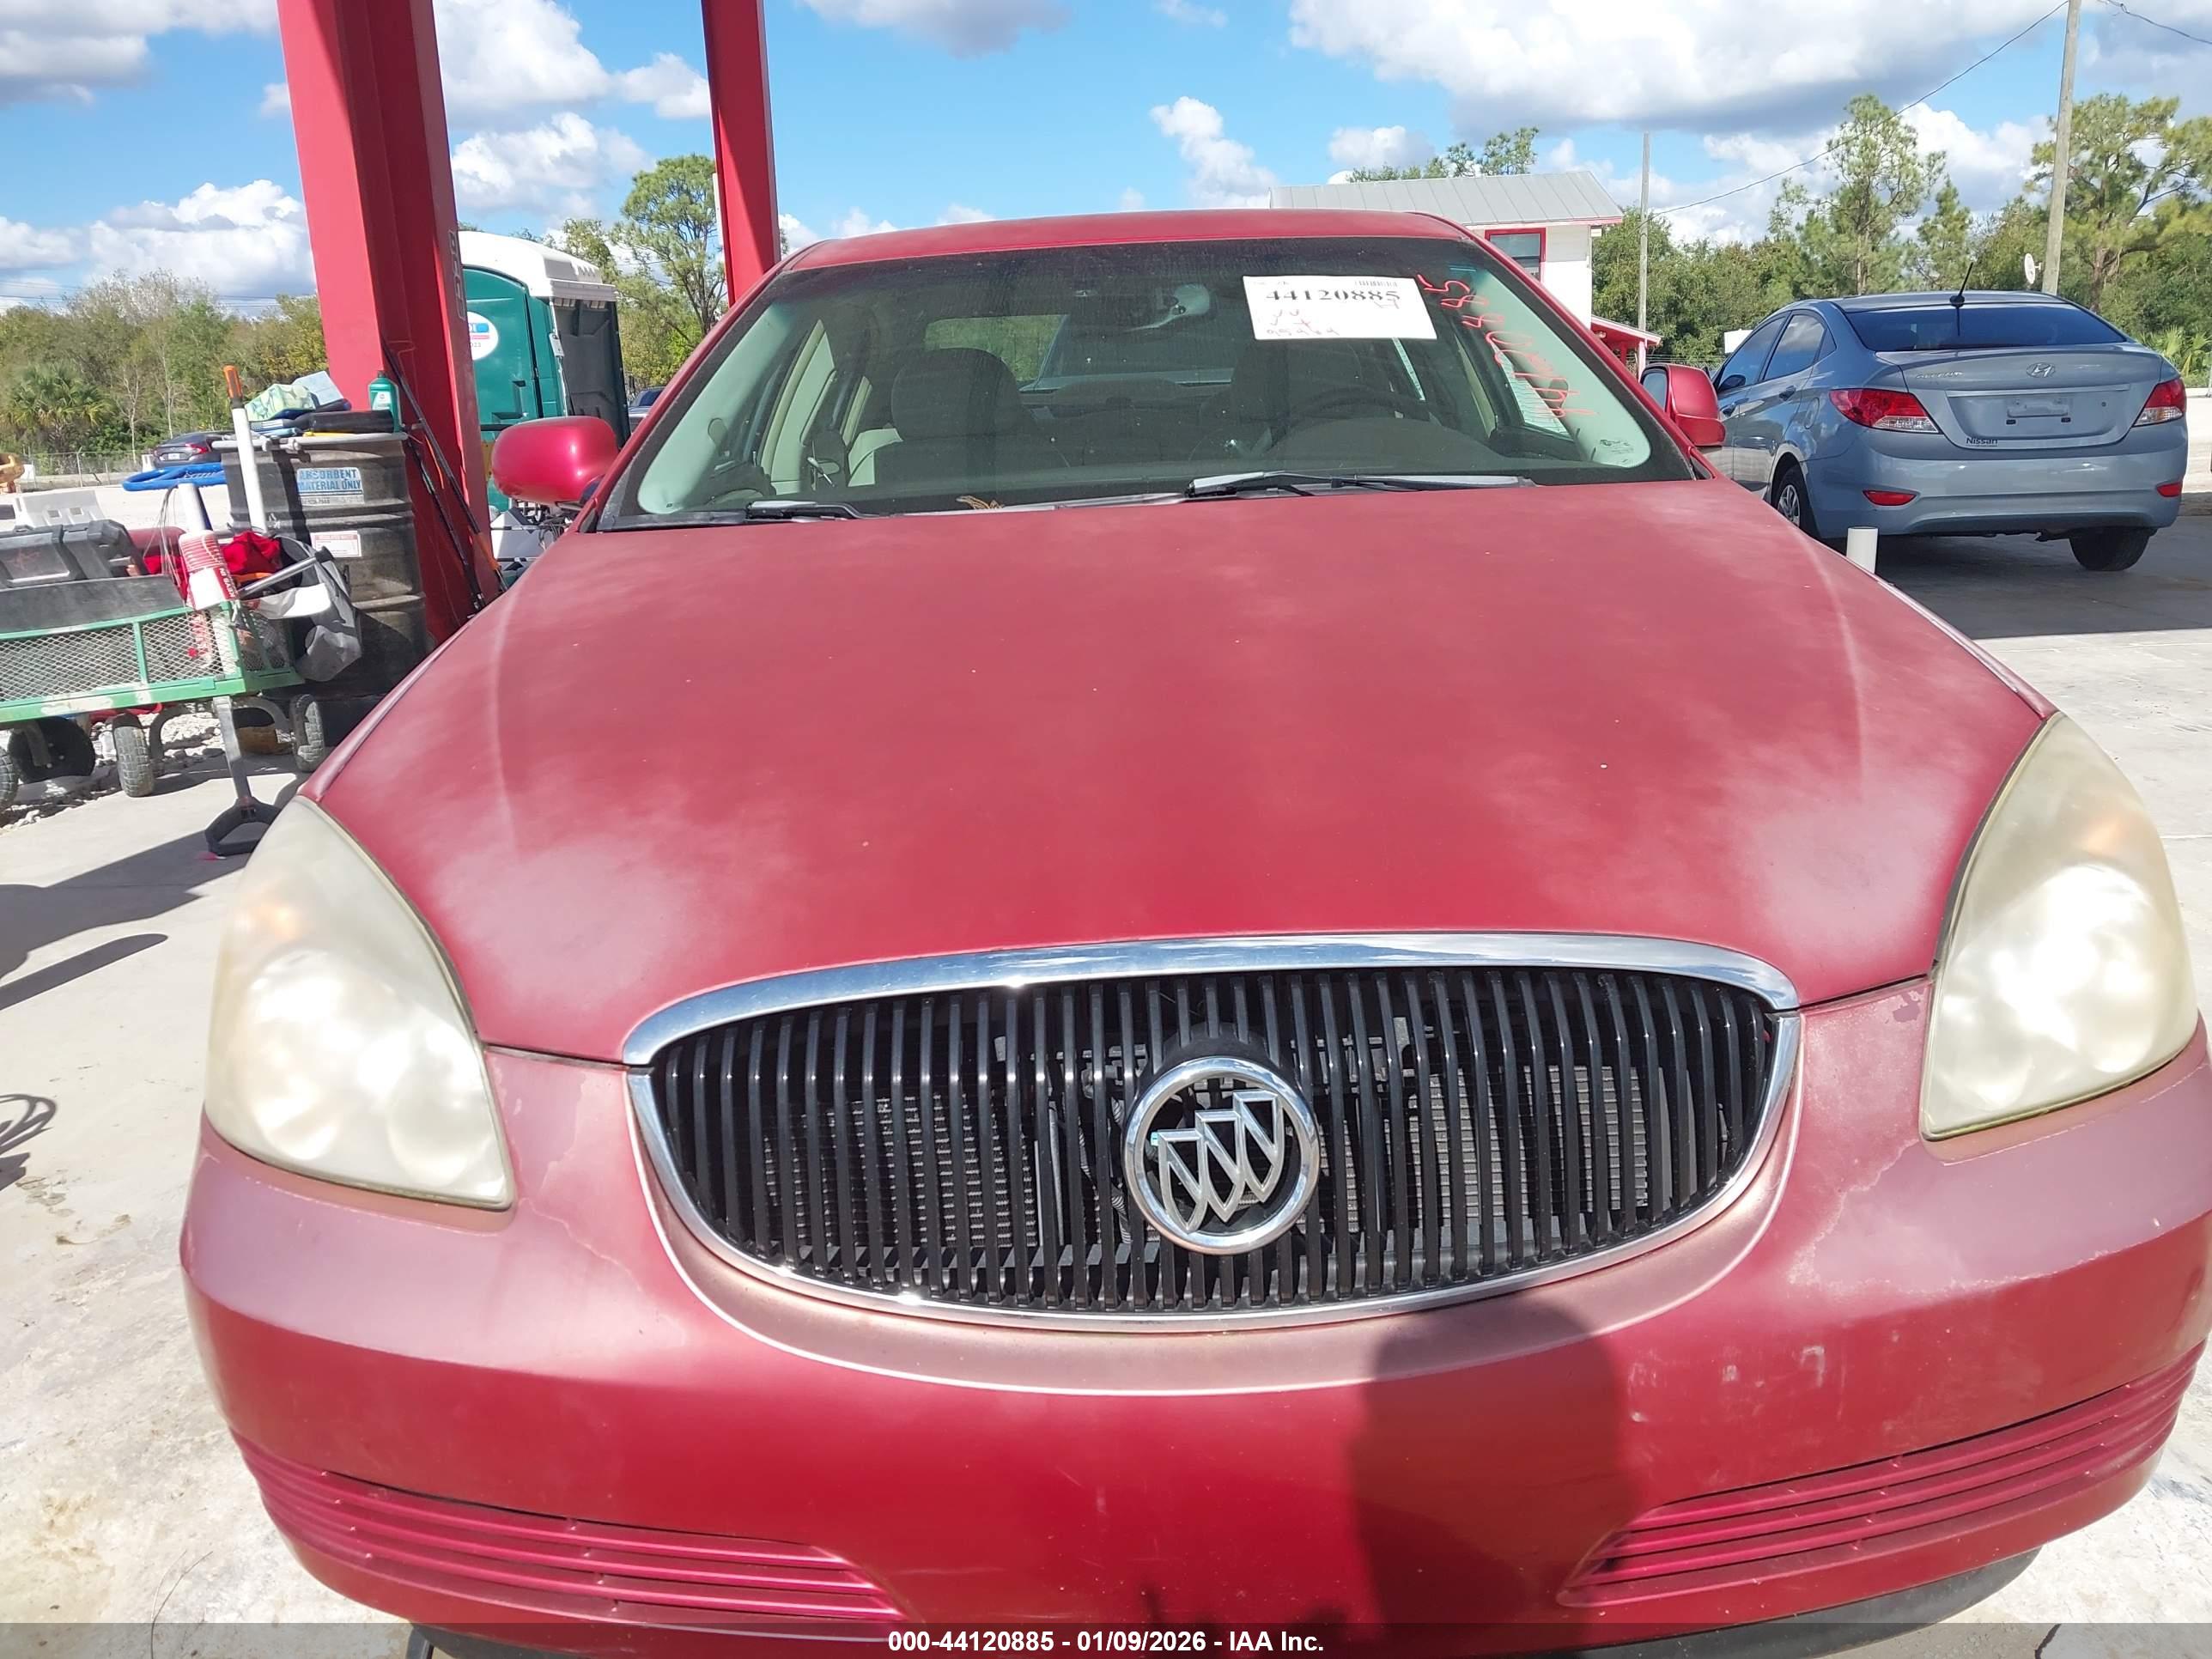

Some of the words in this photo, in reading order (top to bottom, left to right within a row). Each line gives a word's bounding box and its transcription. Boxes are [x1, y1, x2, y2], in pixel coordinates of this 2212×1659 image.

[1266, 289, 1401, 301] 44120885
[300, 469, 357, 480] ABSORBENT
[298, 482, 341, 491] MATERIAL
[343, 480, 362, 489] ONLY
